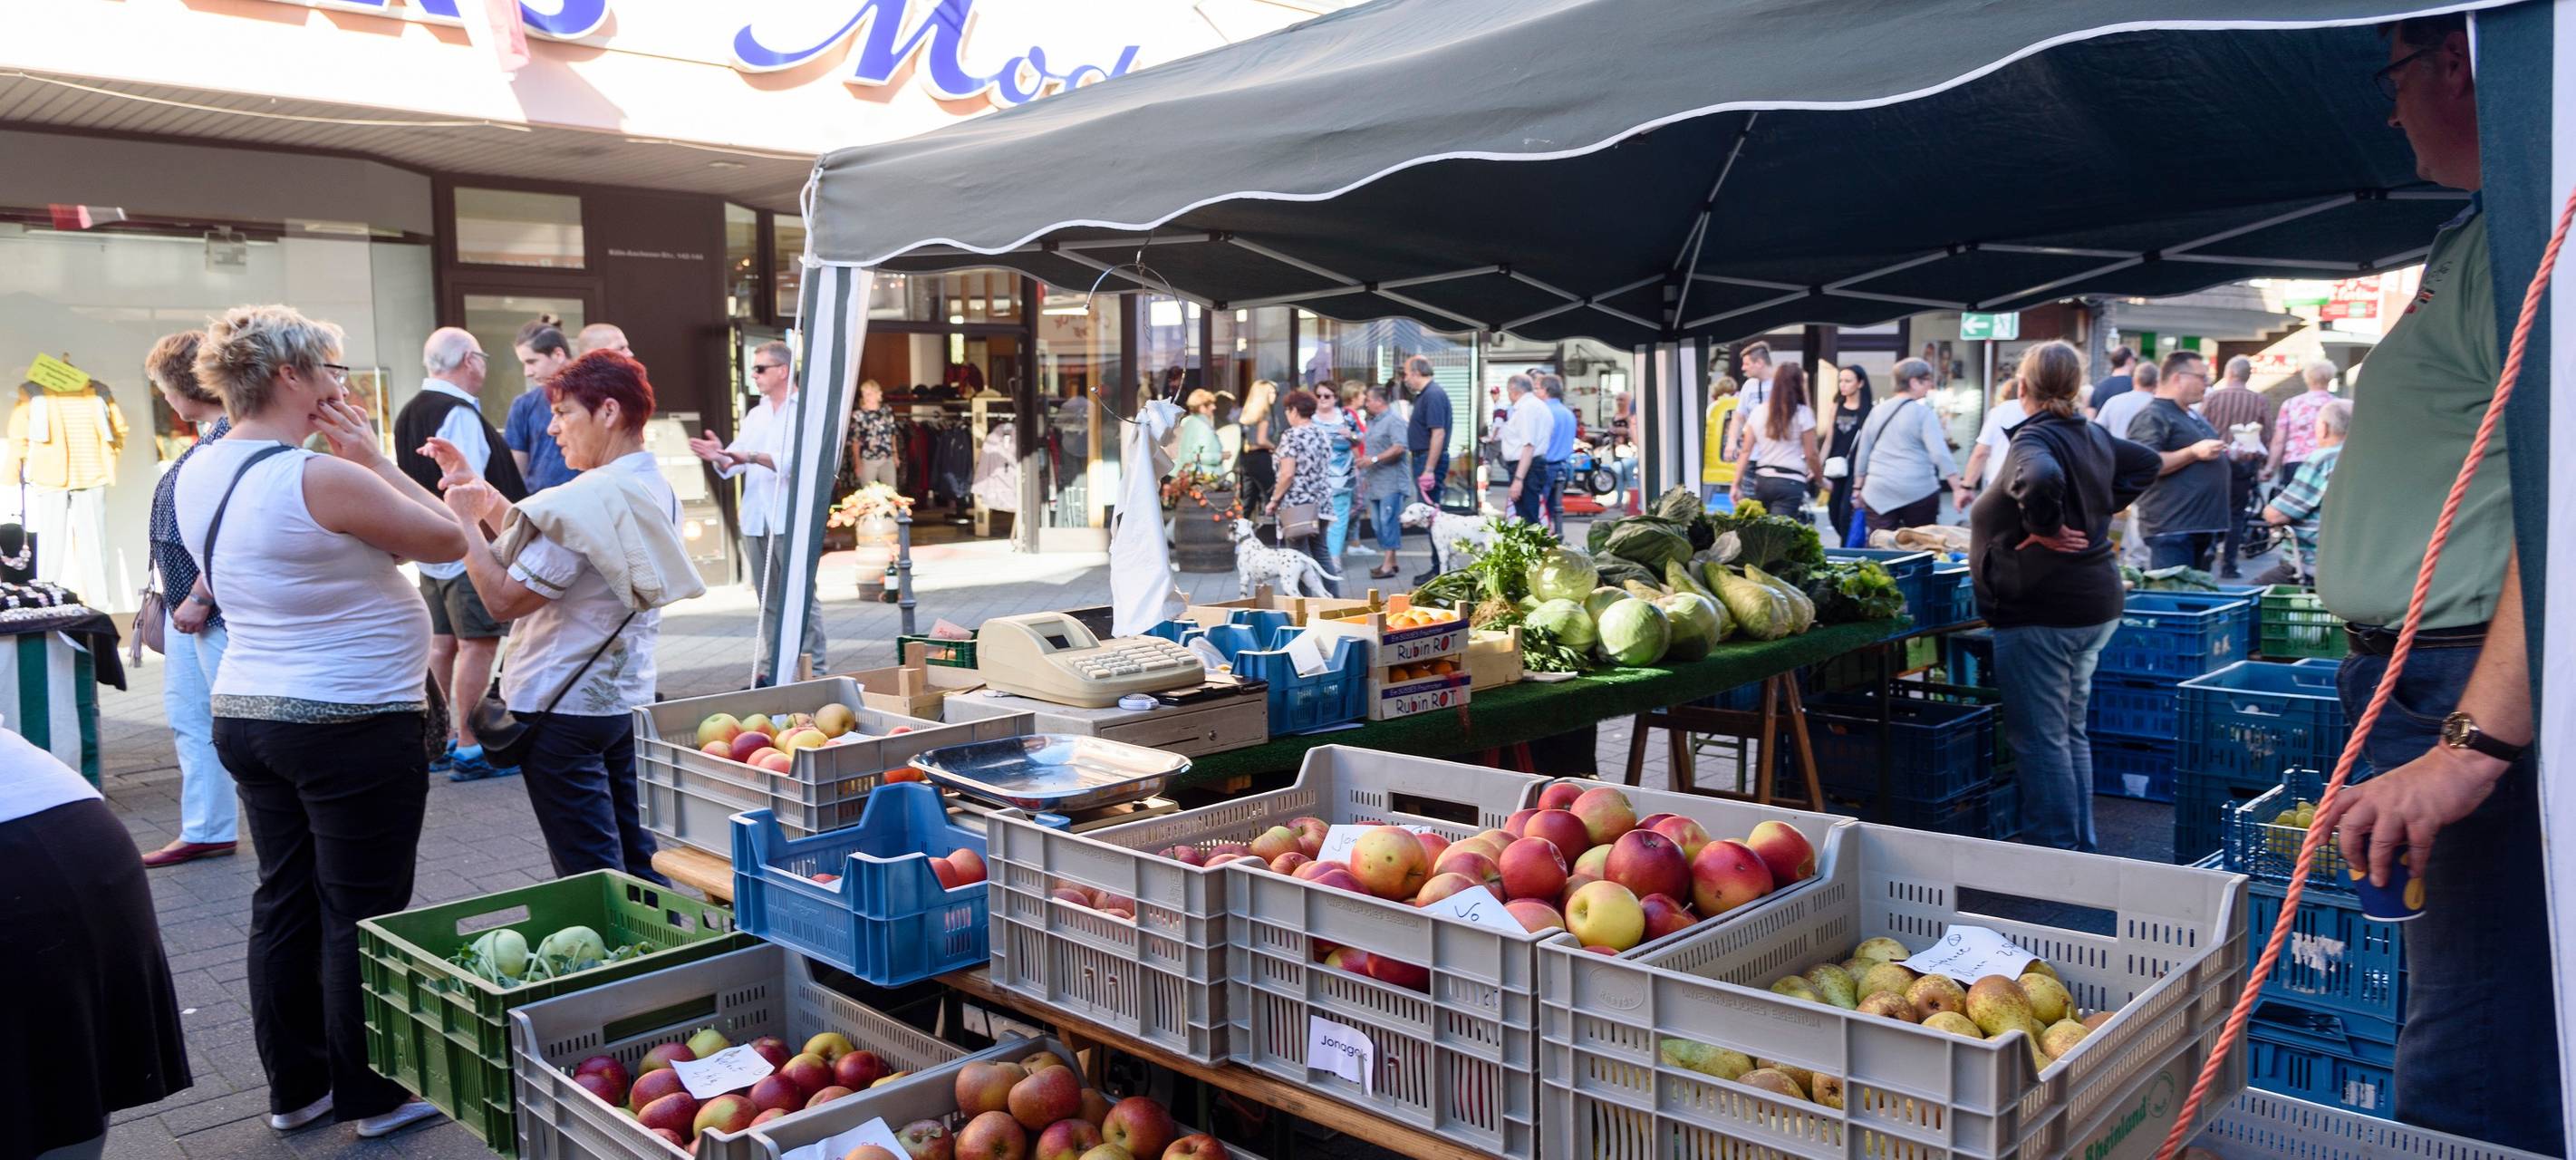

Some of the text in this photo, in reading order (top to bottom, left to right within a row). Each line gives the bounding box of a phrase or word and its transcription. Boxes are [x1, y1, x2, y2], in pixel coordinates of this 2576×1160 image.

[1397, 633, 1457, 660] Rubin ROT
[1395, 690, 1456, 714] Rubin ROT
[2086, 1095, 2147, 1160] Rheinland
